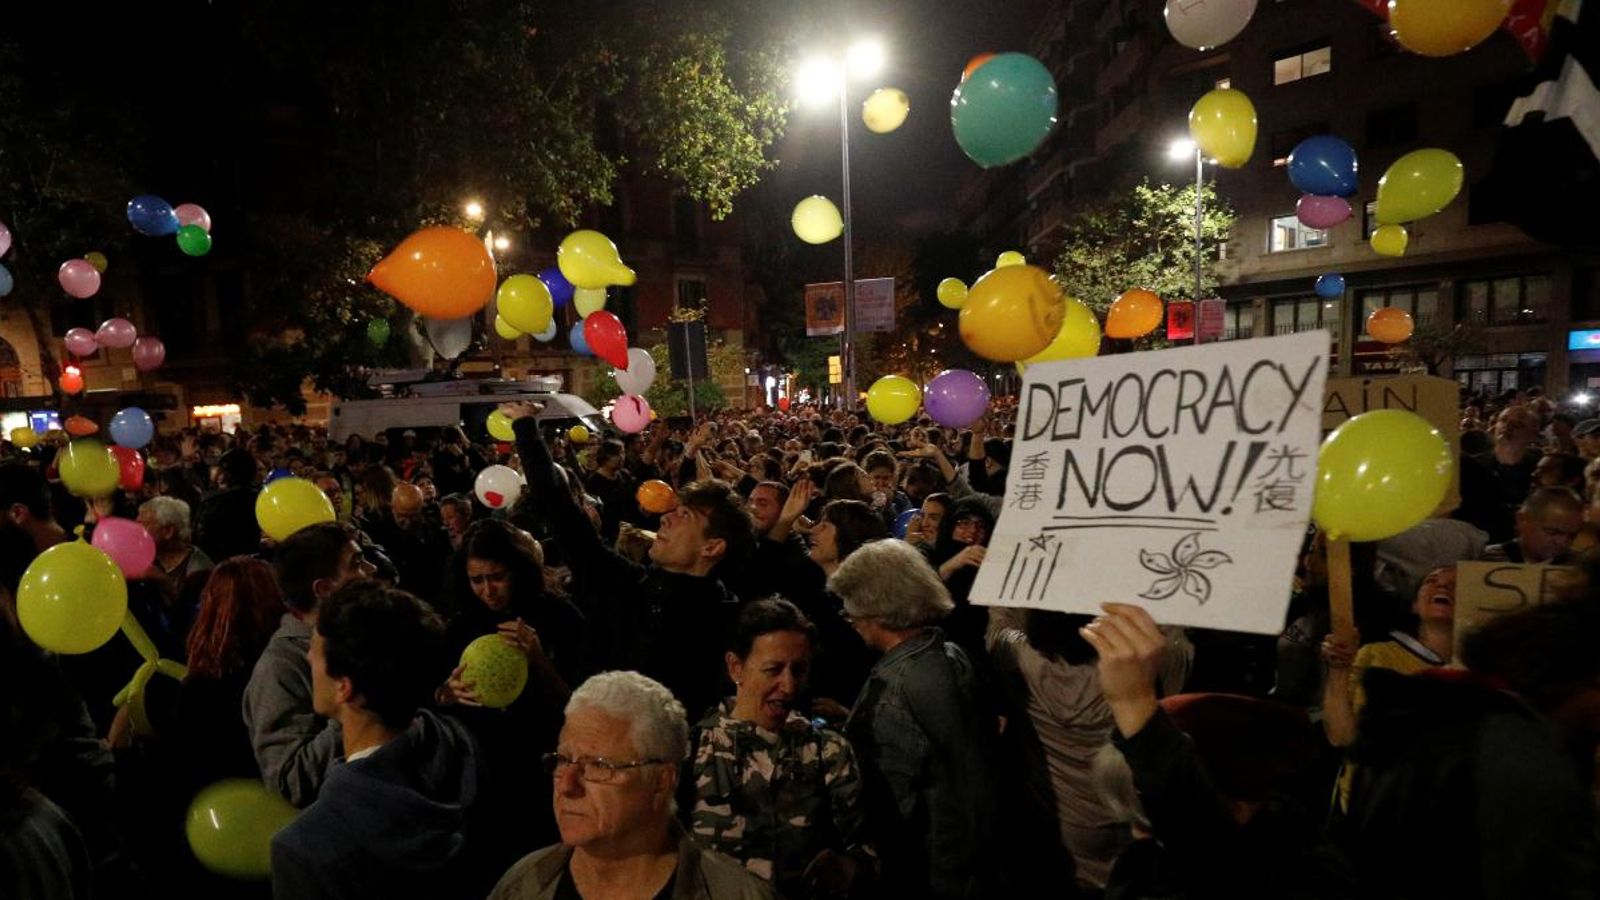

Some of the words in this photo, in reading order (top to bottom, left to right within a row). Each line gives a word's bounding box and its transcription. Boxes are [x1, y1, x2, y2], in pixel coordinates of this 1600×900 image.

[1022, 355, 1321, 441] DEMOCRACY
[1009, 450, 1050, 511] 香港
[1056, 440, 1269, 515] NOW!
[1254, 444, 1310, 514] 光復
